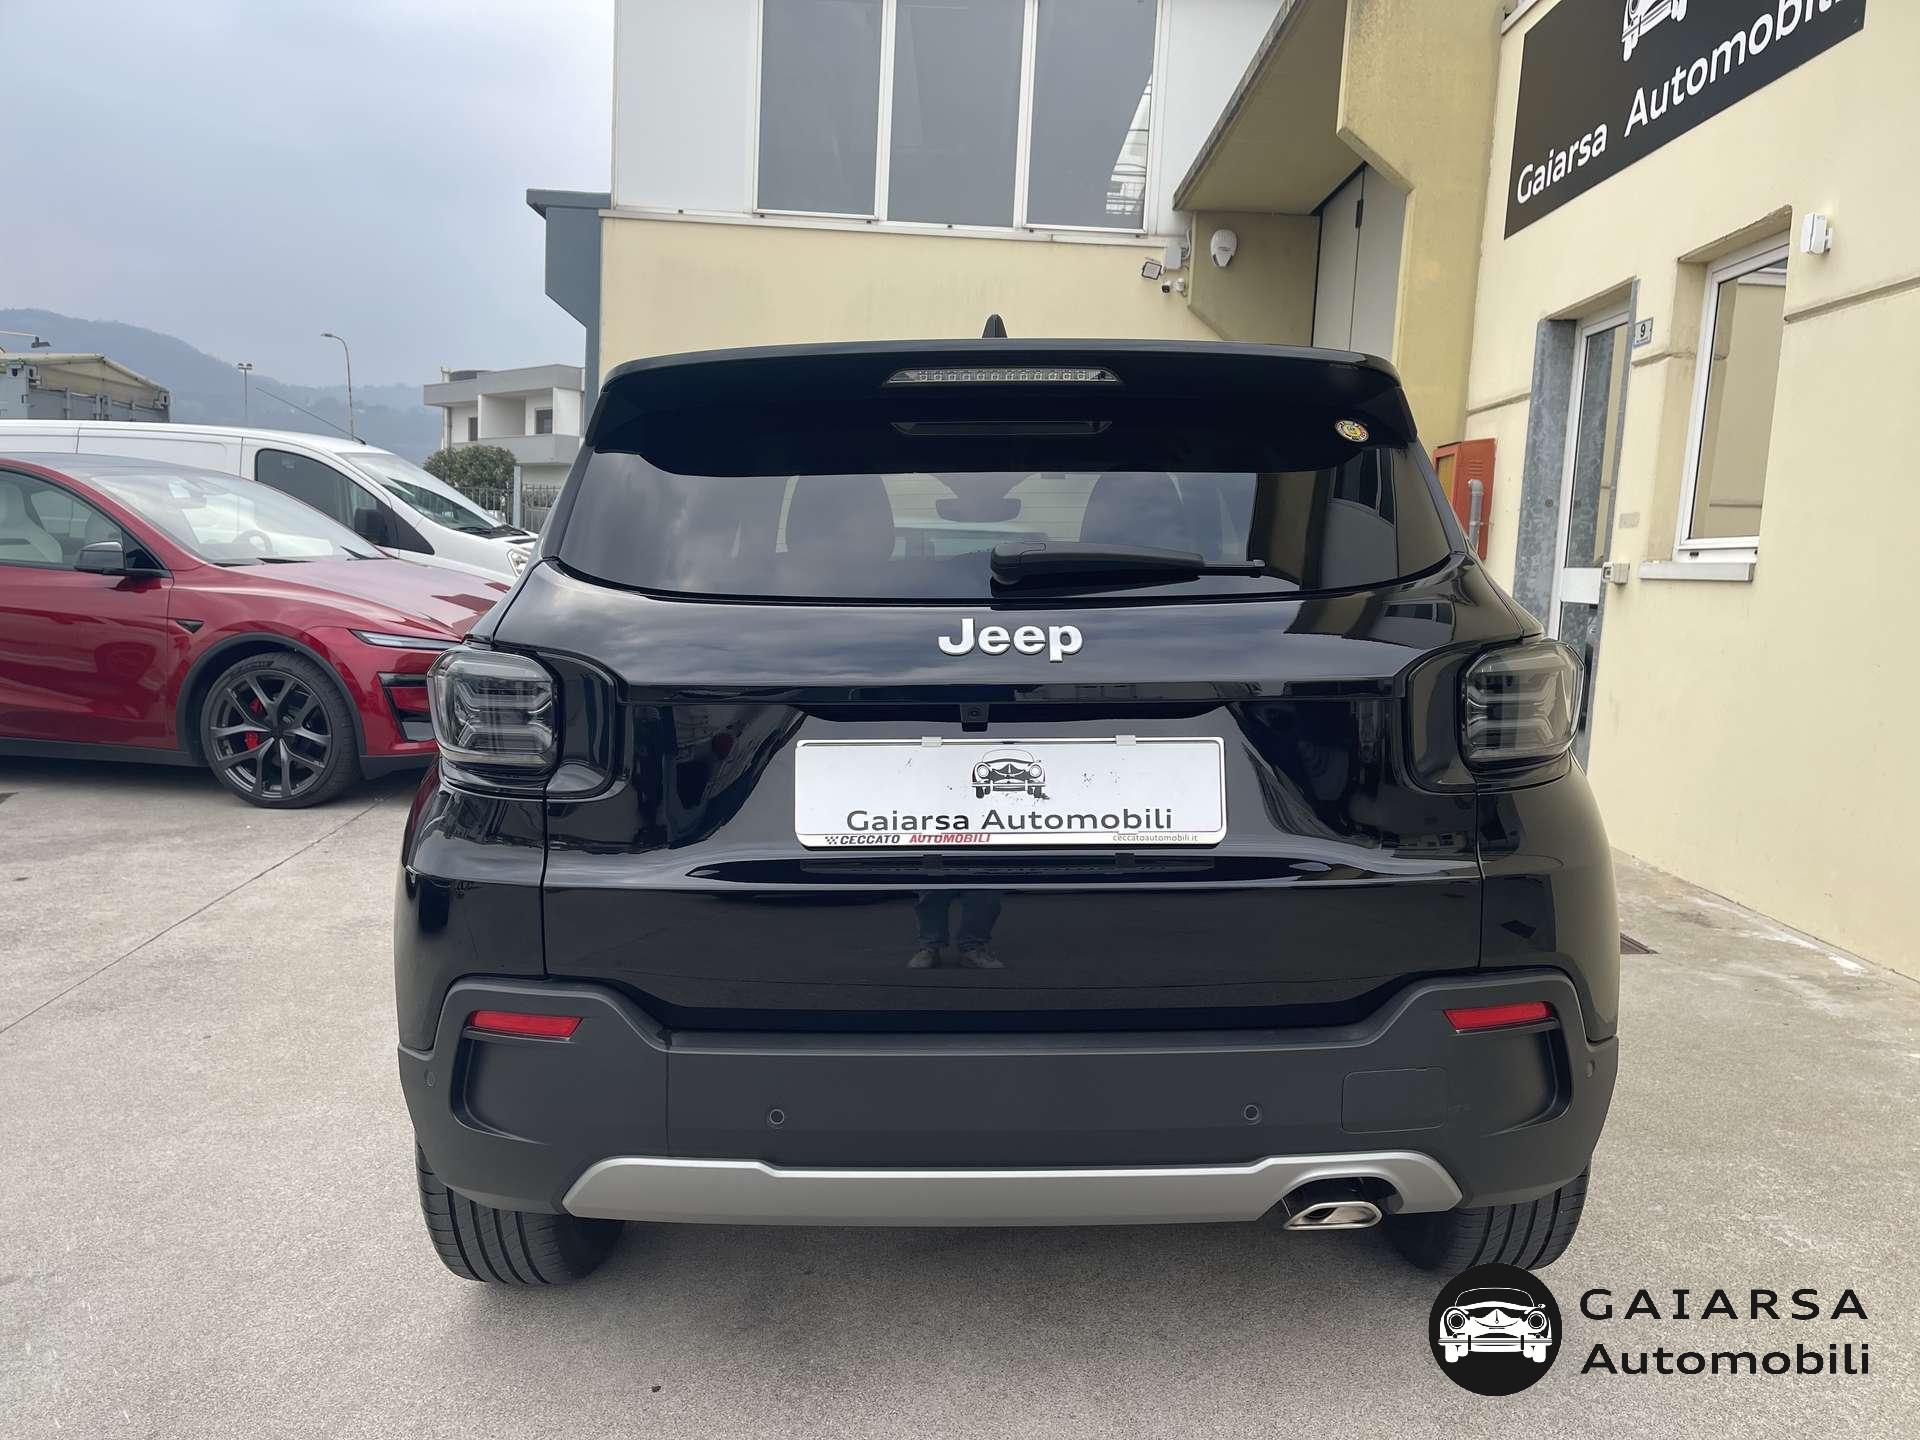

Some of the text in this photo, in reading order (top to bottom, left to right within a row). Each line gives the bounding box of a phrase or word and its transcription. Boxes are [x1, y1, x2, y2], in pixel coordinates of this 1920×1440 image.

[1517, 123, 1608, 204] Gaiarsa
[1640, 323, 1646, 338] 9
[938, 618, 1083, 663] Jeep
[846, 808, 1172, 832] Gaiarsa Automobili
[840, 832, 991, 845] CECCATO AUTOMOBILI
[1112, 832, 1198, 842] ceccatoautomobili.it
